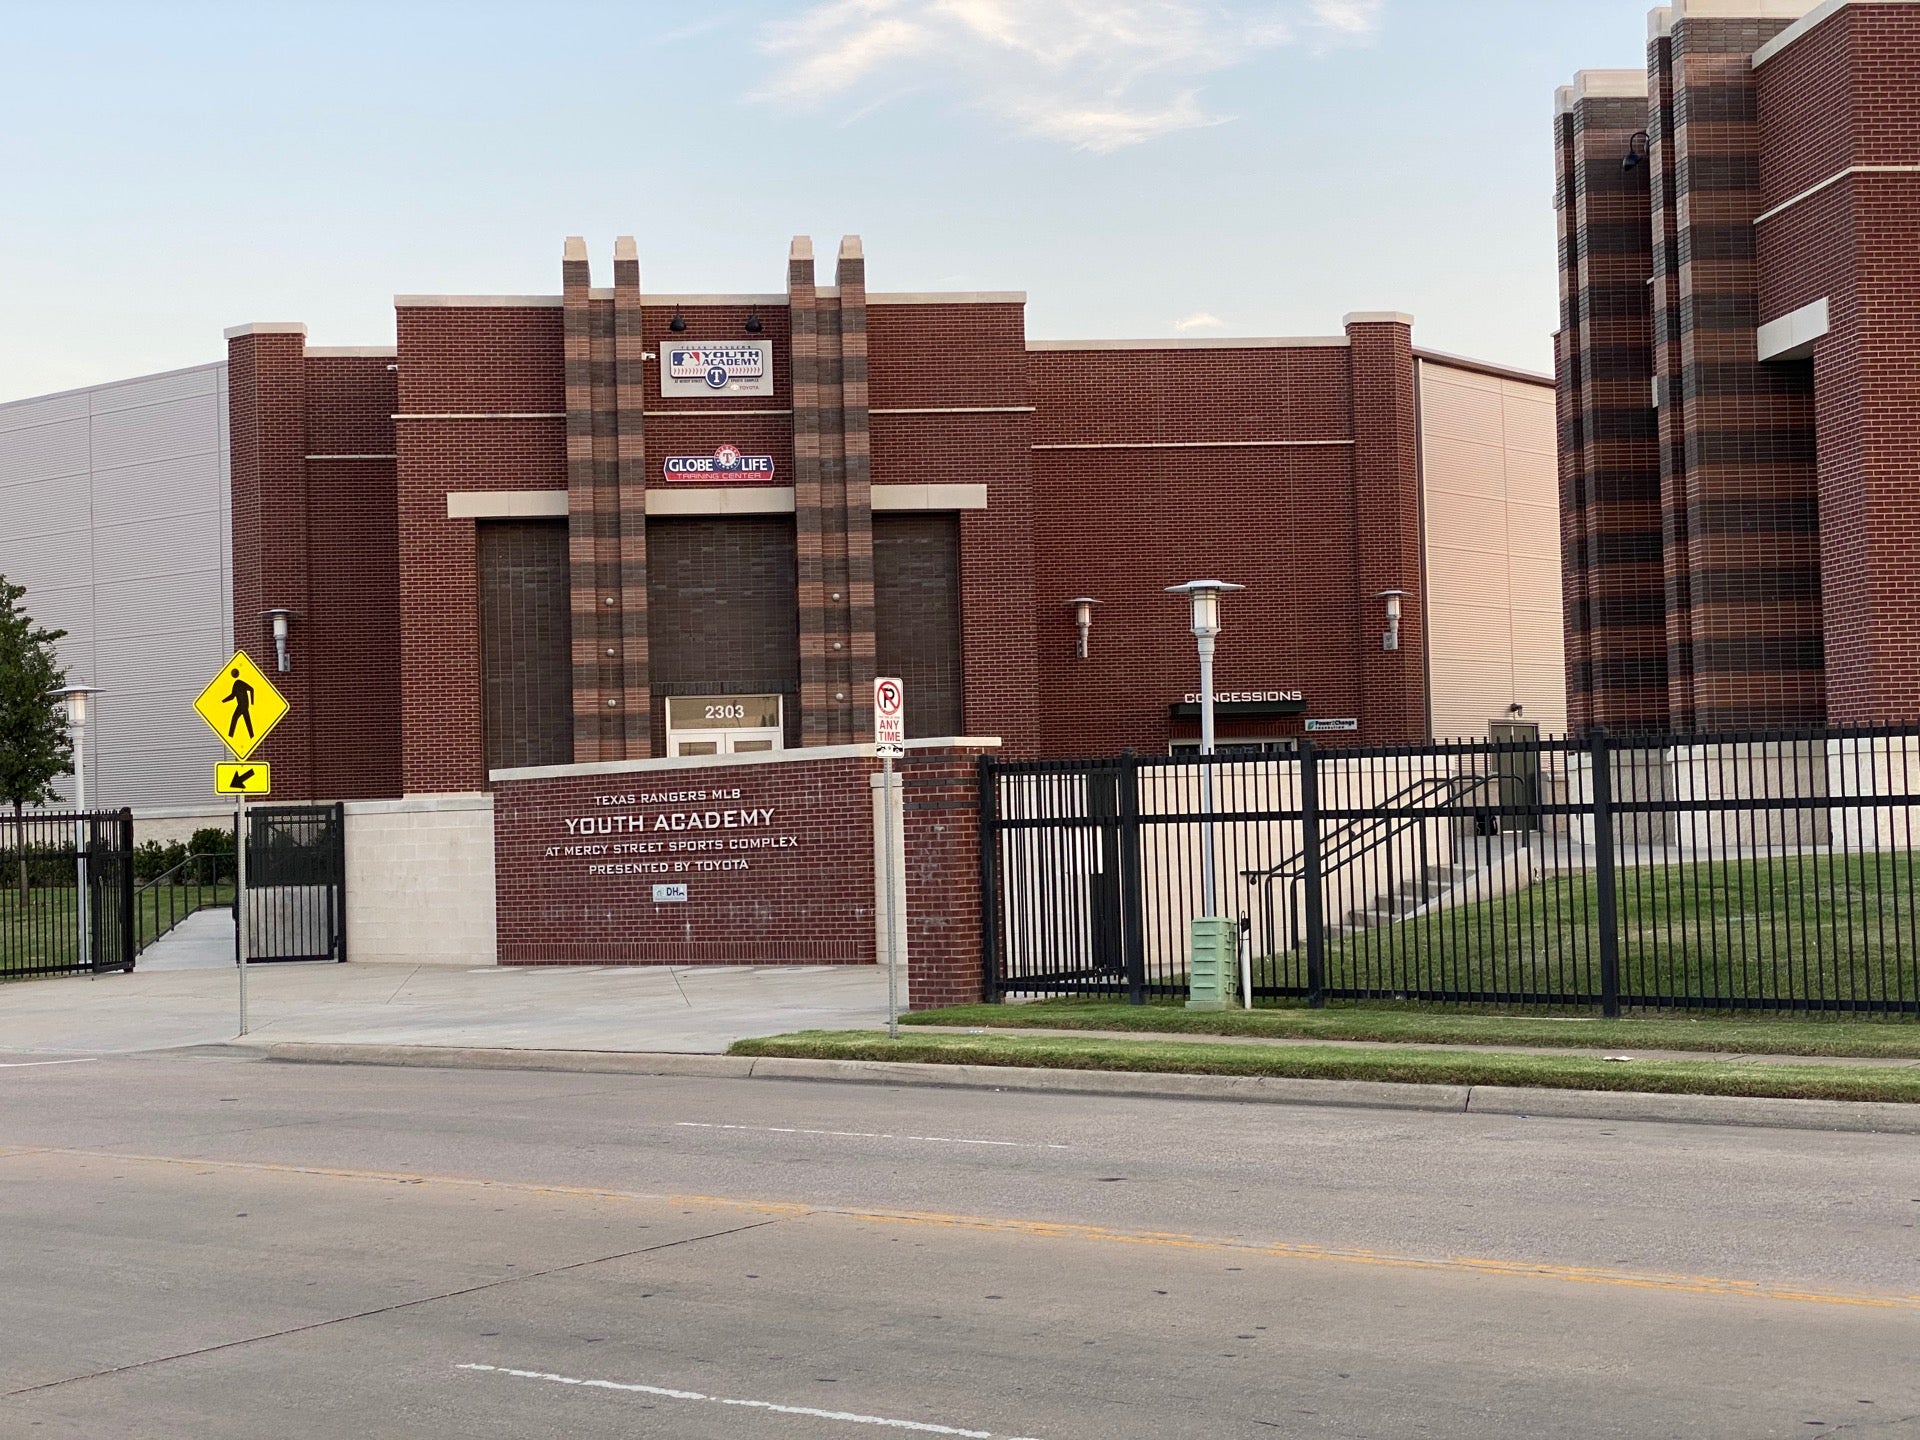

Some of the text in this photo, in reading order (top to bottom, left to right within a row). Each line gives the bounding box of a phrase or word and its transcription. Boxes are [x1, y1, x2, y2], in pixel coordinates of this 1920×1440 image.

[702, 358, 759, 366] ACADEMY
[710, 369, 723, 383] T
[668, 459, 714, 472] GLOBE
[741, 458, 768, 471] LIFE
[704, 704, 745, 719] 2303
[879, 719, 900, 730] ANY
[878, 731, 901, 742] TIME
[595, 788, 741, 806] TEXAS RANGERS MLB
[565, 808, 775, 835] YOUTH ACADEMY
[545, 836, 799, 857] AT MERCY STREET SPORTS COMPLEX
[588, 858, 749, 875] PRESENTED BY TOYOTA
